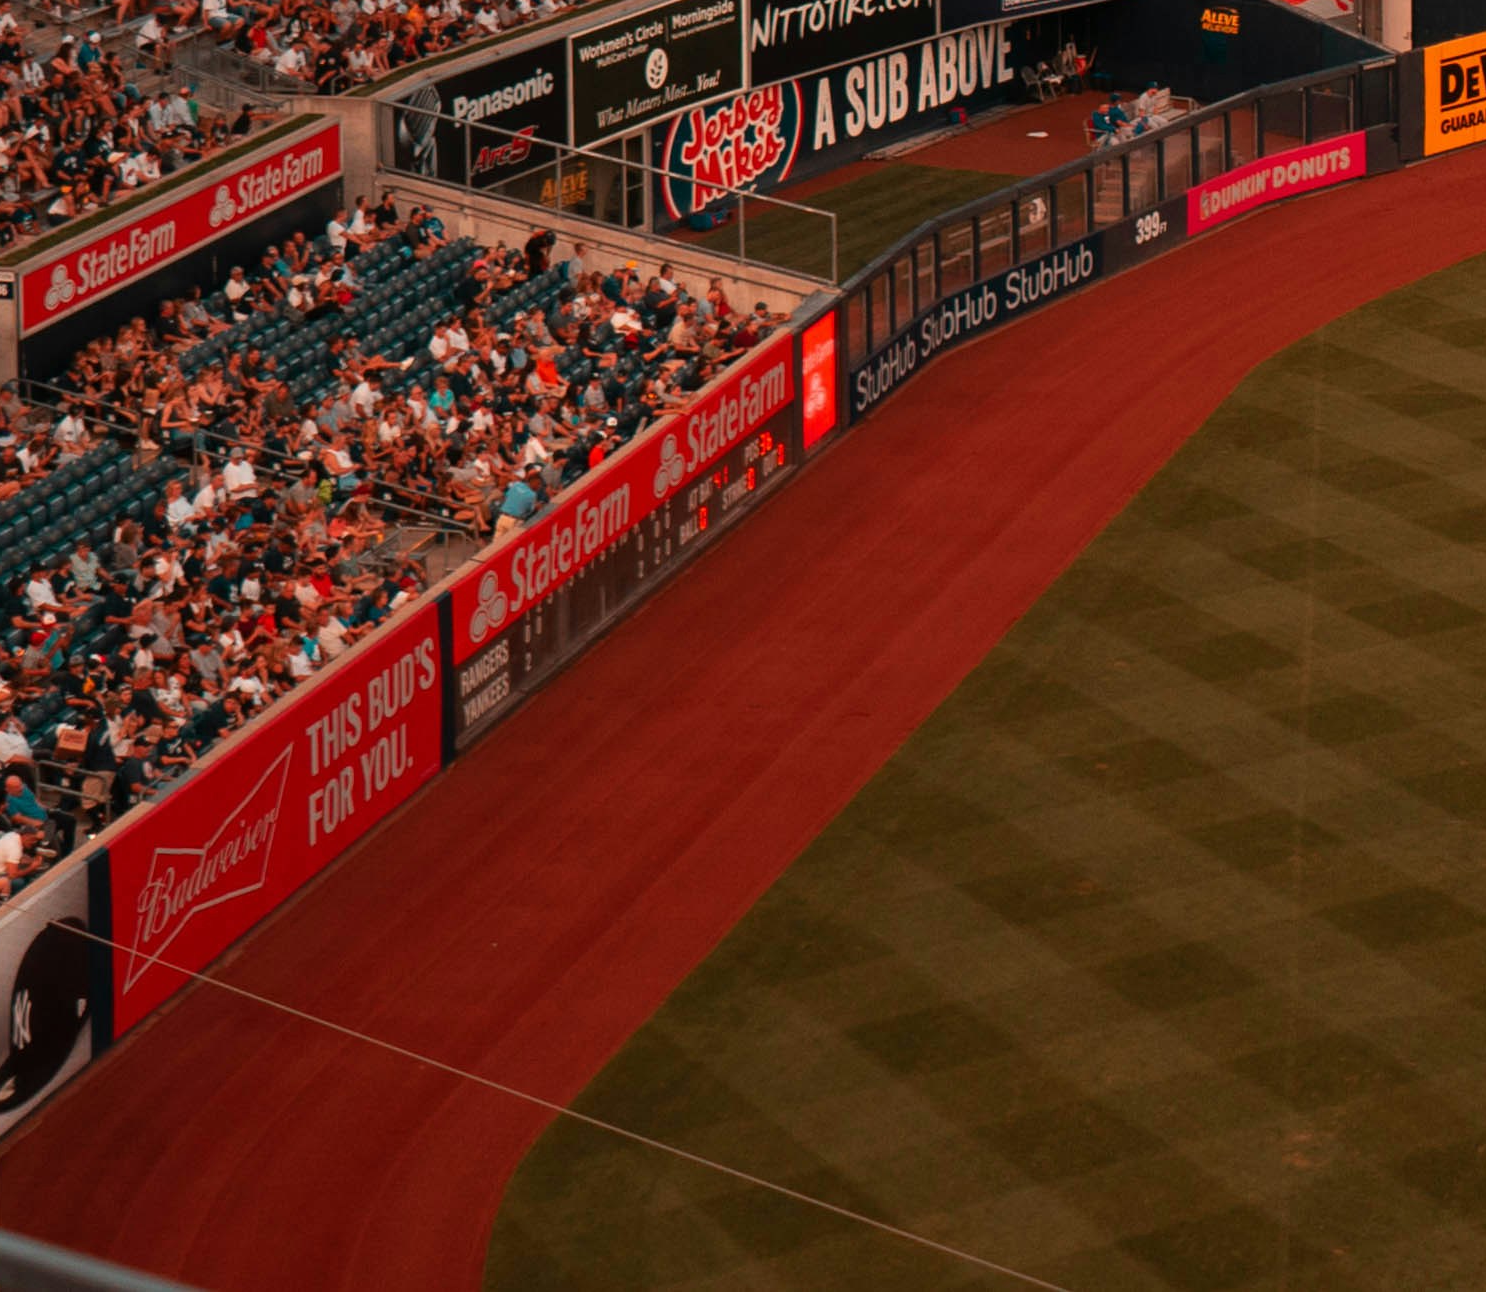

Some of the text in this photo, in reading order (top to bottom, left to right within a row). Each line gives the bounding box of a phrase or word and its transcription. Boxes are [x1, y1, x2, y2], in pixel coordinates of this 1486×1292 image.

[578, 30, 634, 63] Workmen's
[635, 21, 664, 41] Circle
[671, 0, 735, 30] Morningside
[1201, 8, 1240, 26] ALEVE
[453, 68, 554, 128] Panasonic
[682, 83, 784, 163] Jersey
[812, 22, 1015, 152] A SUB ABOVE
[1211, 144, 1352, 218] DUNKIN' DONUTS
[855, 334, 917, 412] StubHub
[919, 280, 997, 357] StubHub
[1005, 244, 1095, 311] StubHub
[459, 639, 509, 694] RANGERS
[463, 671, 510, 728] YANKEES
[305, 636, 437, 779] THIS BUD'S
[307, 723, 414, 847] FOR YOU.
[137, 805, 281, 946] Budweiser
